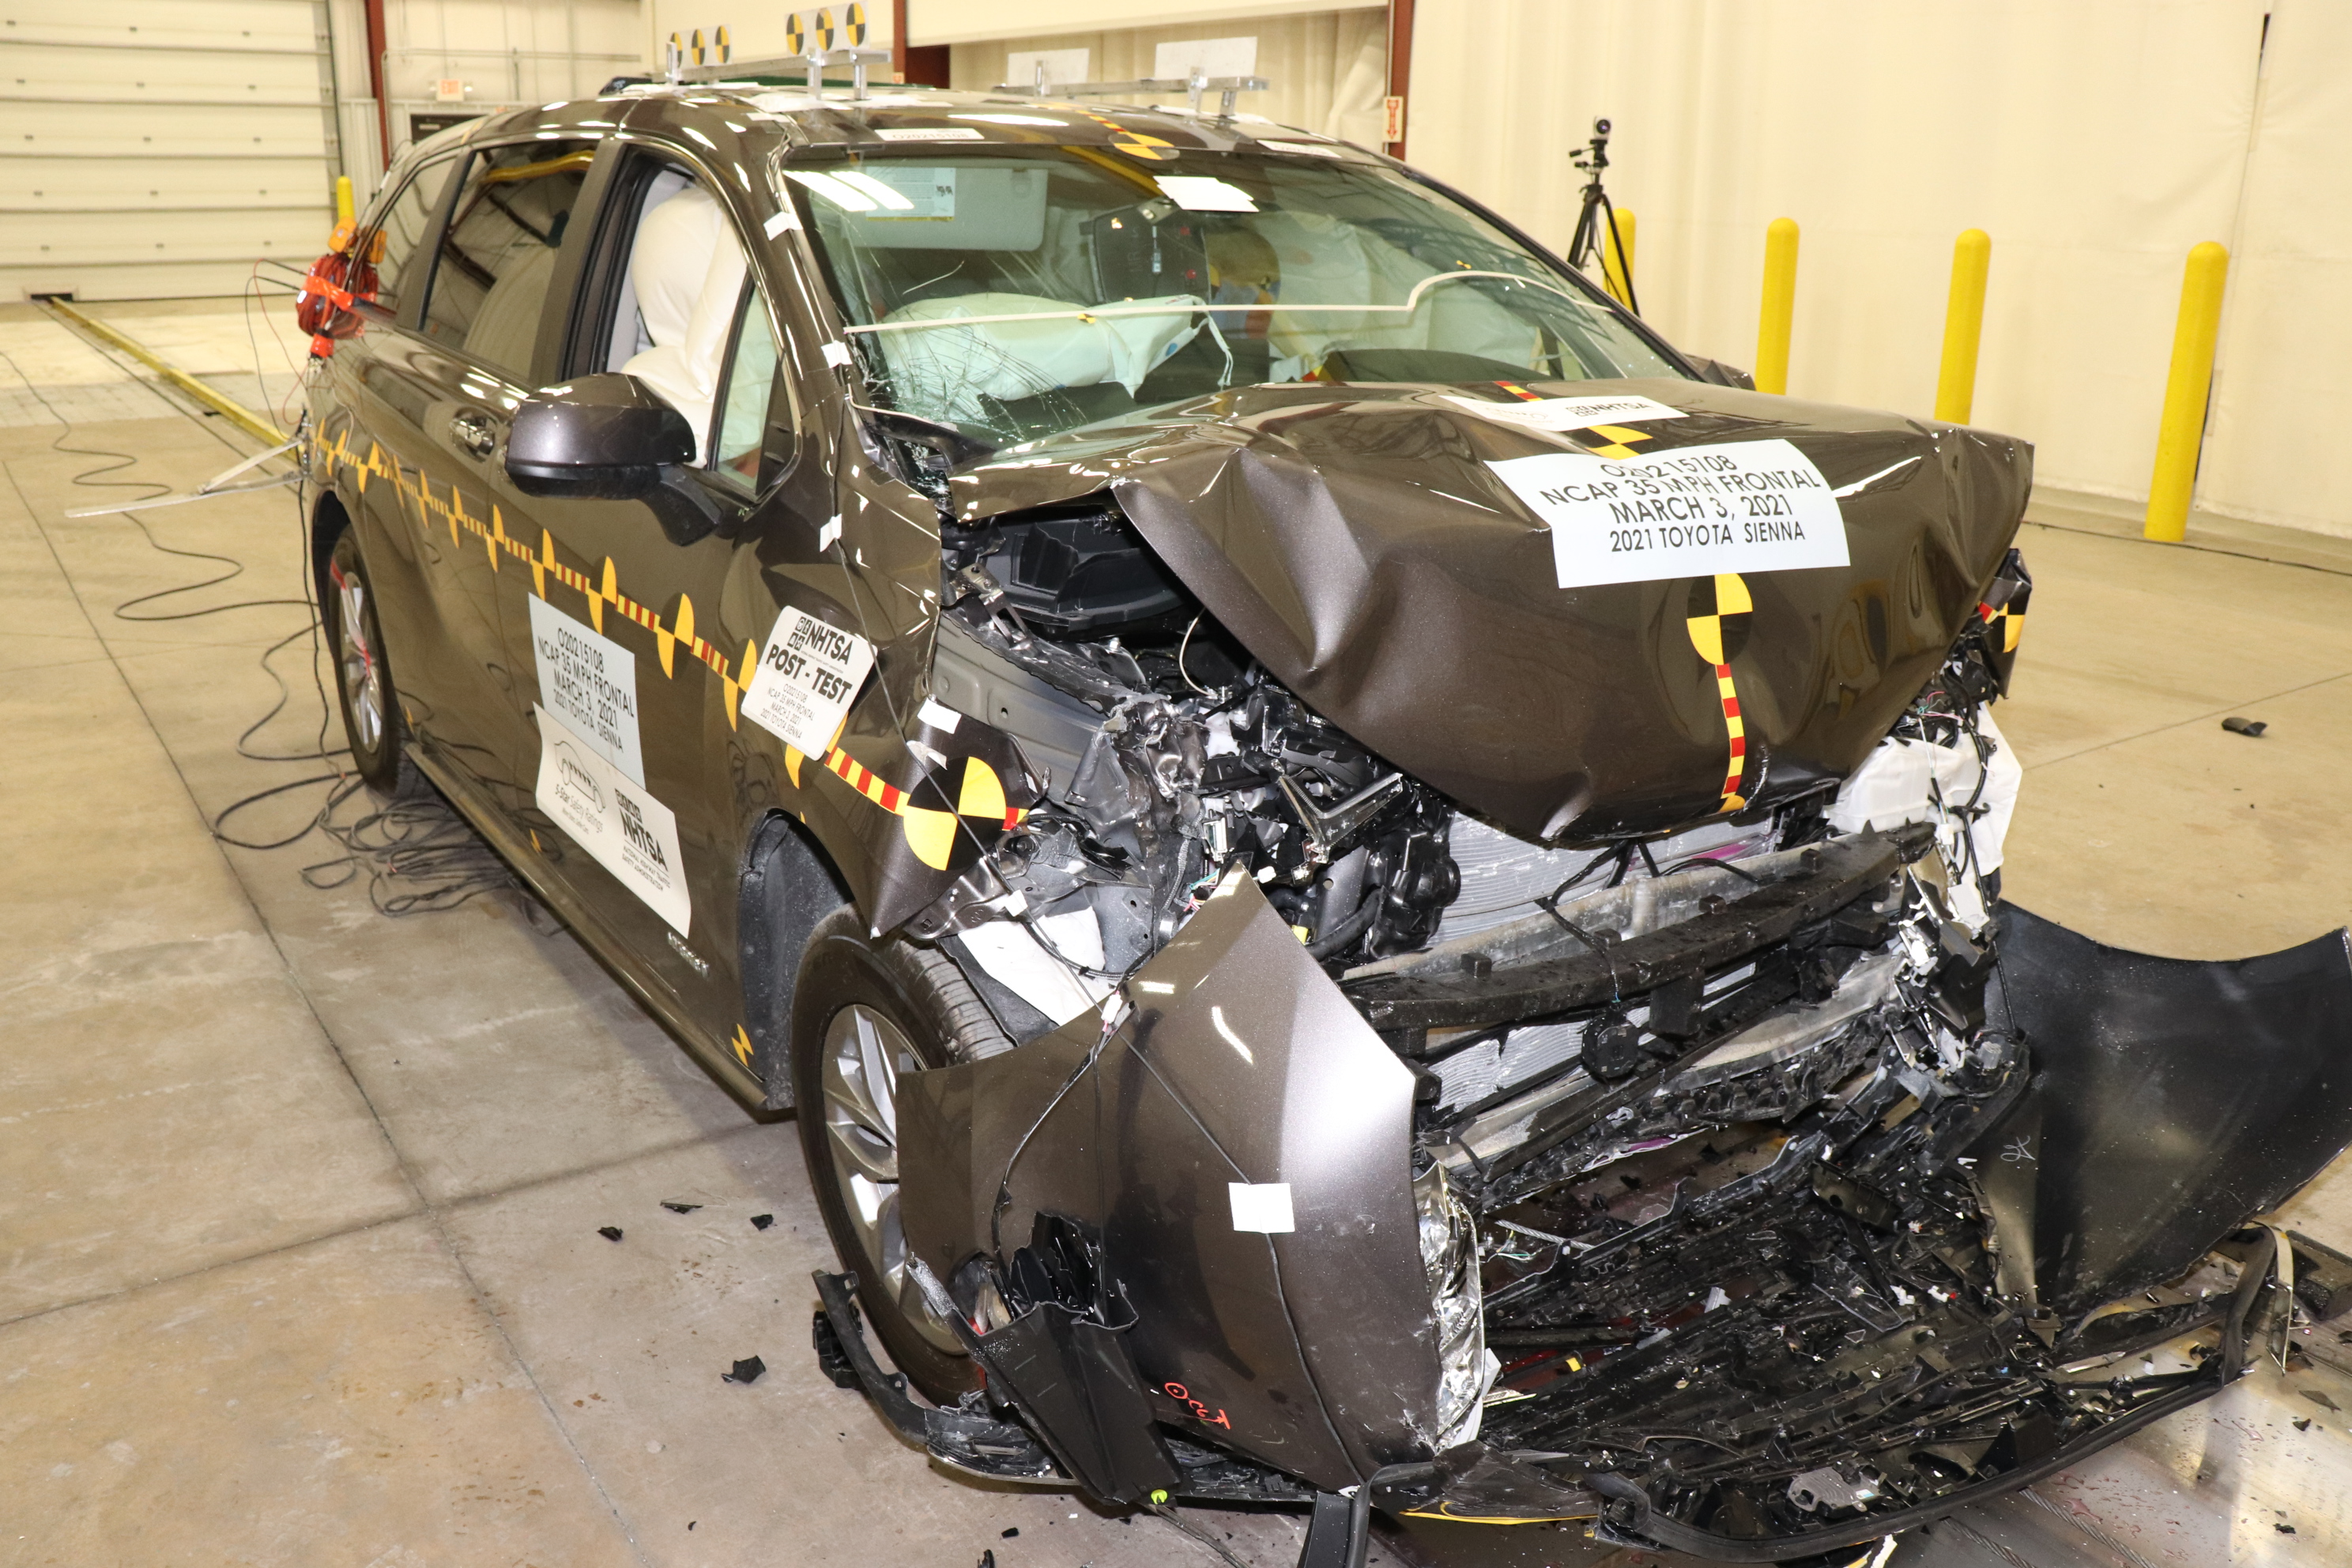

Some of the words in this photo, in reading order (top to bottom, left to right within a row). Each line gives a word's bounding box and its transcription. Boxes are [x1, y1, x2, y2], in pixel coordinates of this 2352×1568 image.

[1591, 402, 1653, 412] NHTSA
[1540, 482, 1619, 505] NCAP
[1624, 479, 1660, 496] 35
[1660, 476, 1720, 494] MPH
[1717, 469, 1821, 493] FRONTAL
[1608, 496, 1706, 524] MARCH
[1709, 496, 1735, 521] 3,
[1740, 494, 1792, 517] 2021
[1610, 529, 1653, 552] 2021
[1659, 524, 1733, 548] TOYOTA
[1744, 521, 1806, 543] SIENNA
[805, 623, 854, 665] NHTSA
[538, 636, 559, 666] NCAP
[562, 651, 571, 674] 35
[573, 660, 592, 689] MPH
[594, 675, 635, 718] FRONTAL
[766, 644, 806, 680] POST
[812, 667, 853, 703] TEST
[554, 670, 583, 706] MARCH
[598, 700, 618, 729] 2021
[771, 702, 787, 717] MARCH
[790, 713, 801, 726] 2021
[795, 703, 815, 721] FRONTAL
[553, 689, 568, 712] 2021
[567, 699, 595, 732] TOYOTA
[597, 722, 624, 753] SIENNA
[760, 708, 771, 720] 2021
[771, 714, 786, 730] TOYOTA
[785, 724, 802, 740] SIENNA
[620, 808, 668, 871] NHTSA
